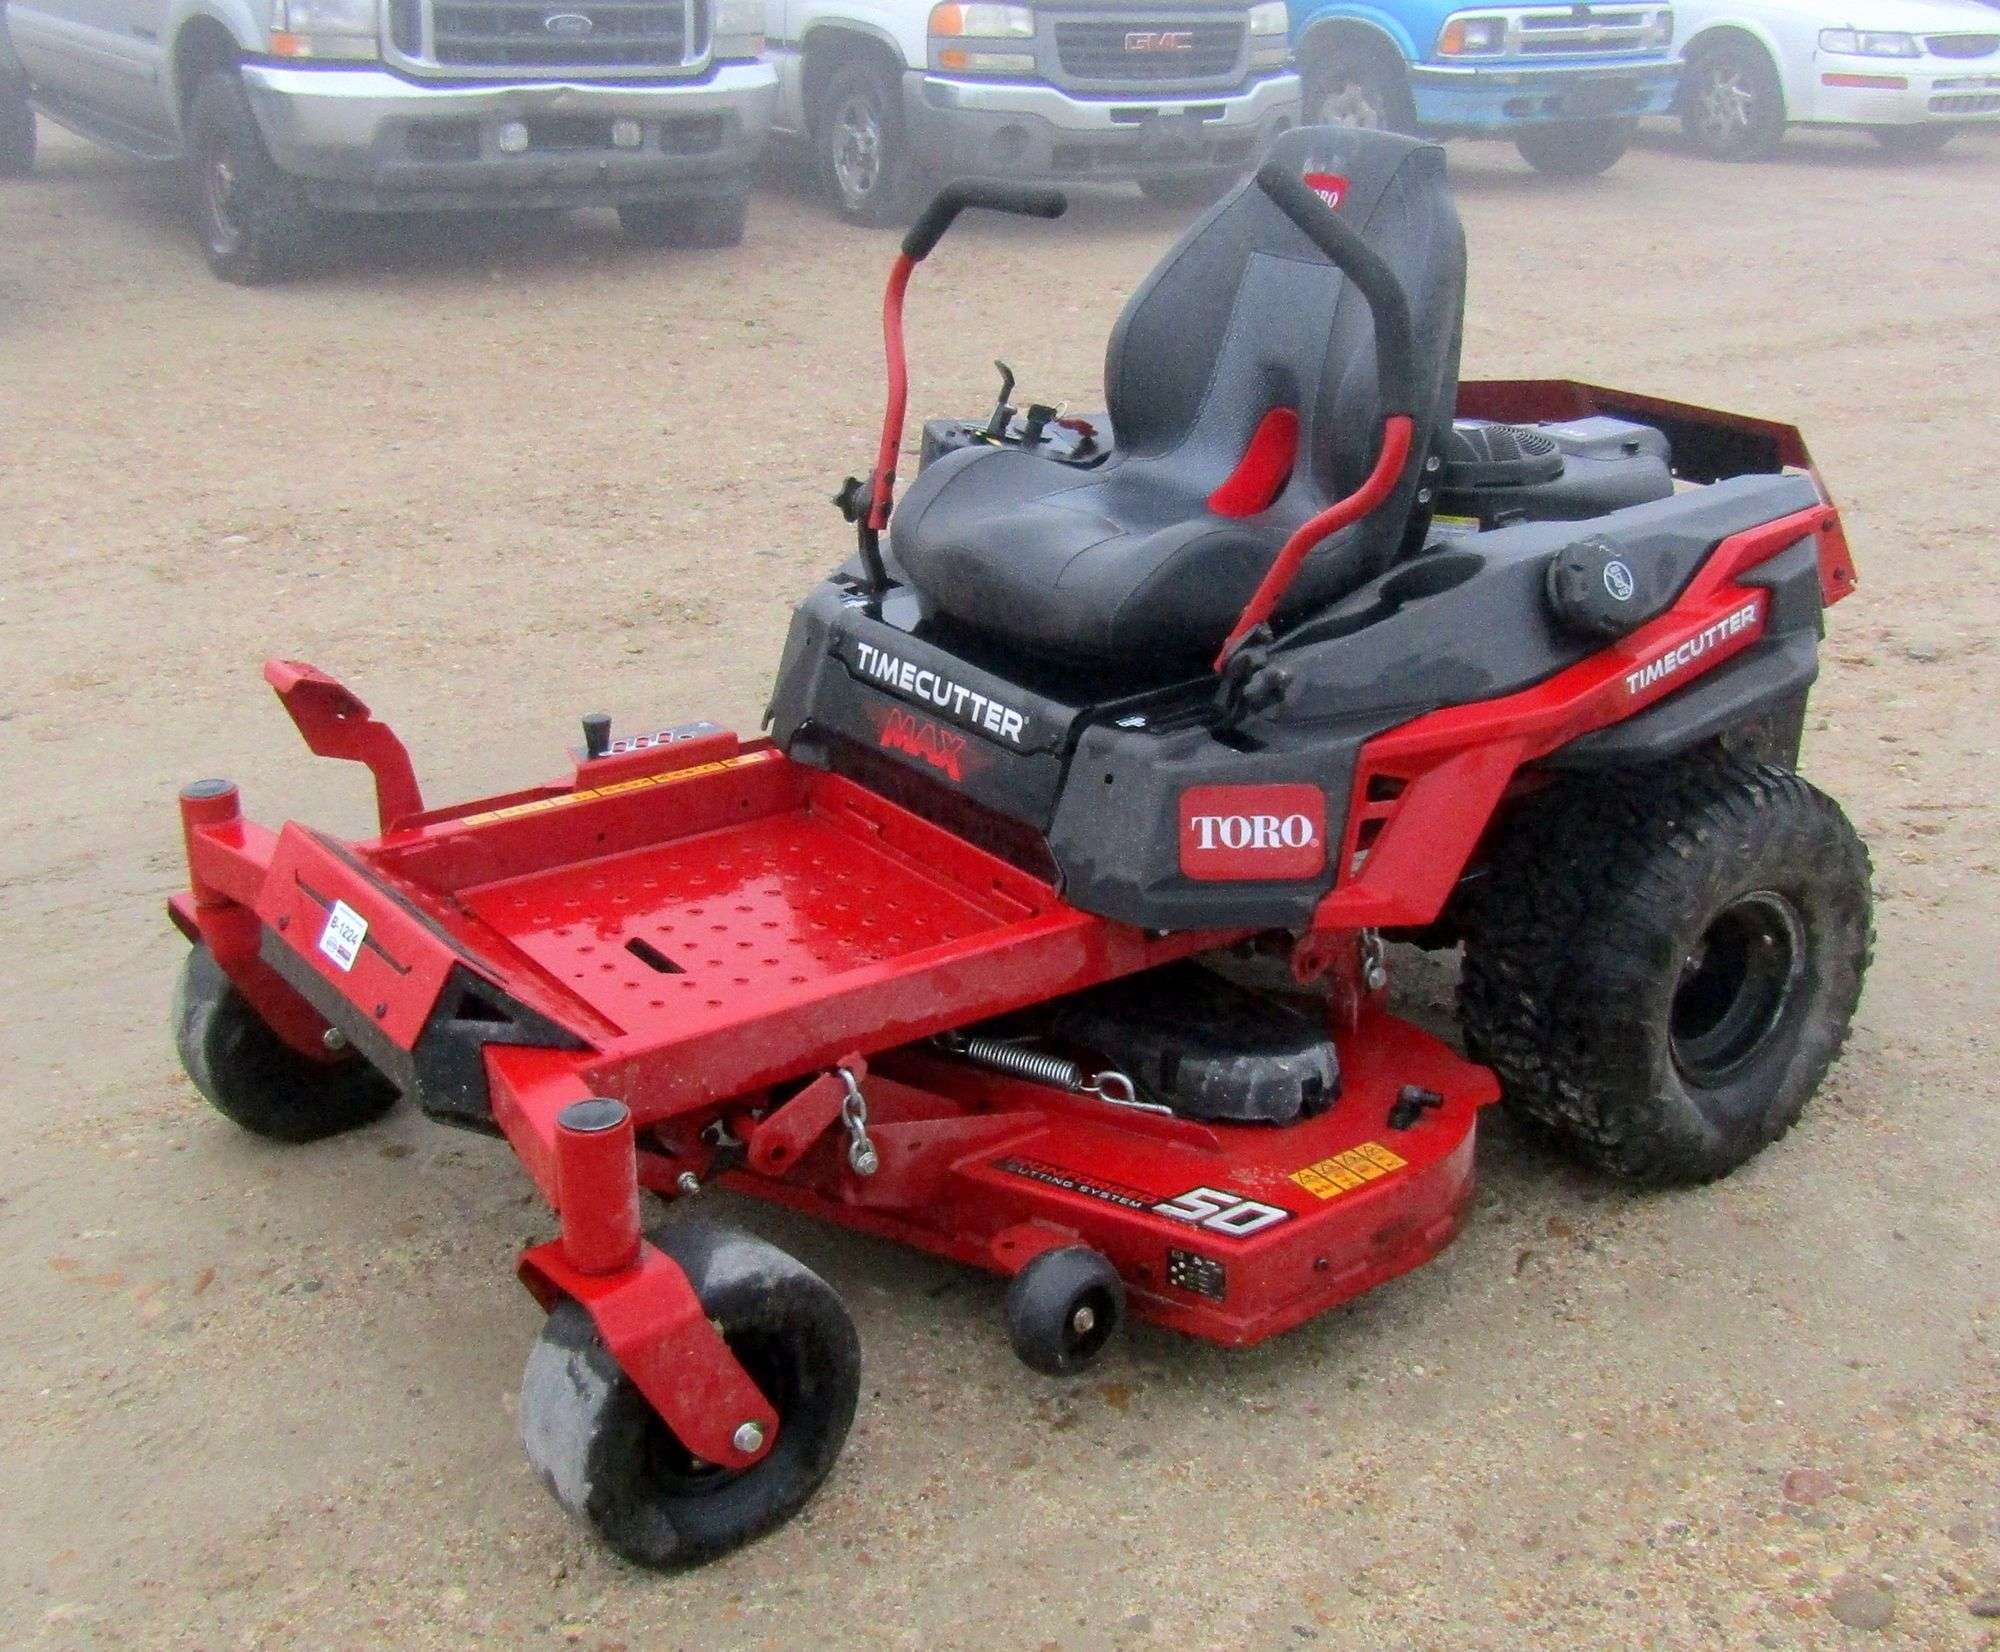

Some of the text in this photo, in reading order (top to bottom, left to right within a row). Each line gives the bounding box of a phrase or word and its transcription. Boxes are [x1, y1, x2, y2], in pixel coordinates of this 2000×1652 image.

[1124, 32, 1193, 50] GMC
[1625, 604, 1757, 694] TIMECUTTER
[857, 641, 1024, 745] TIMECUTTER
[879, 707, 967, 783] MAX
[1190, 814, 1313, 850] TORO
[1078, 1184, 1143, 1209] SYSTEM
[1151, 1187, 1289, 1235] 50
